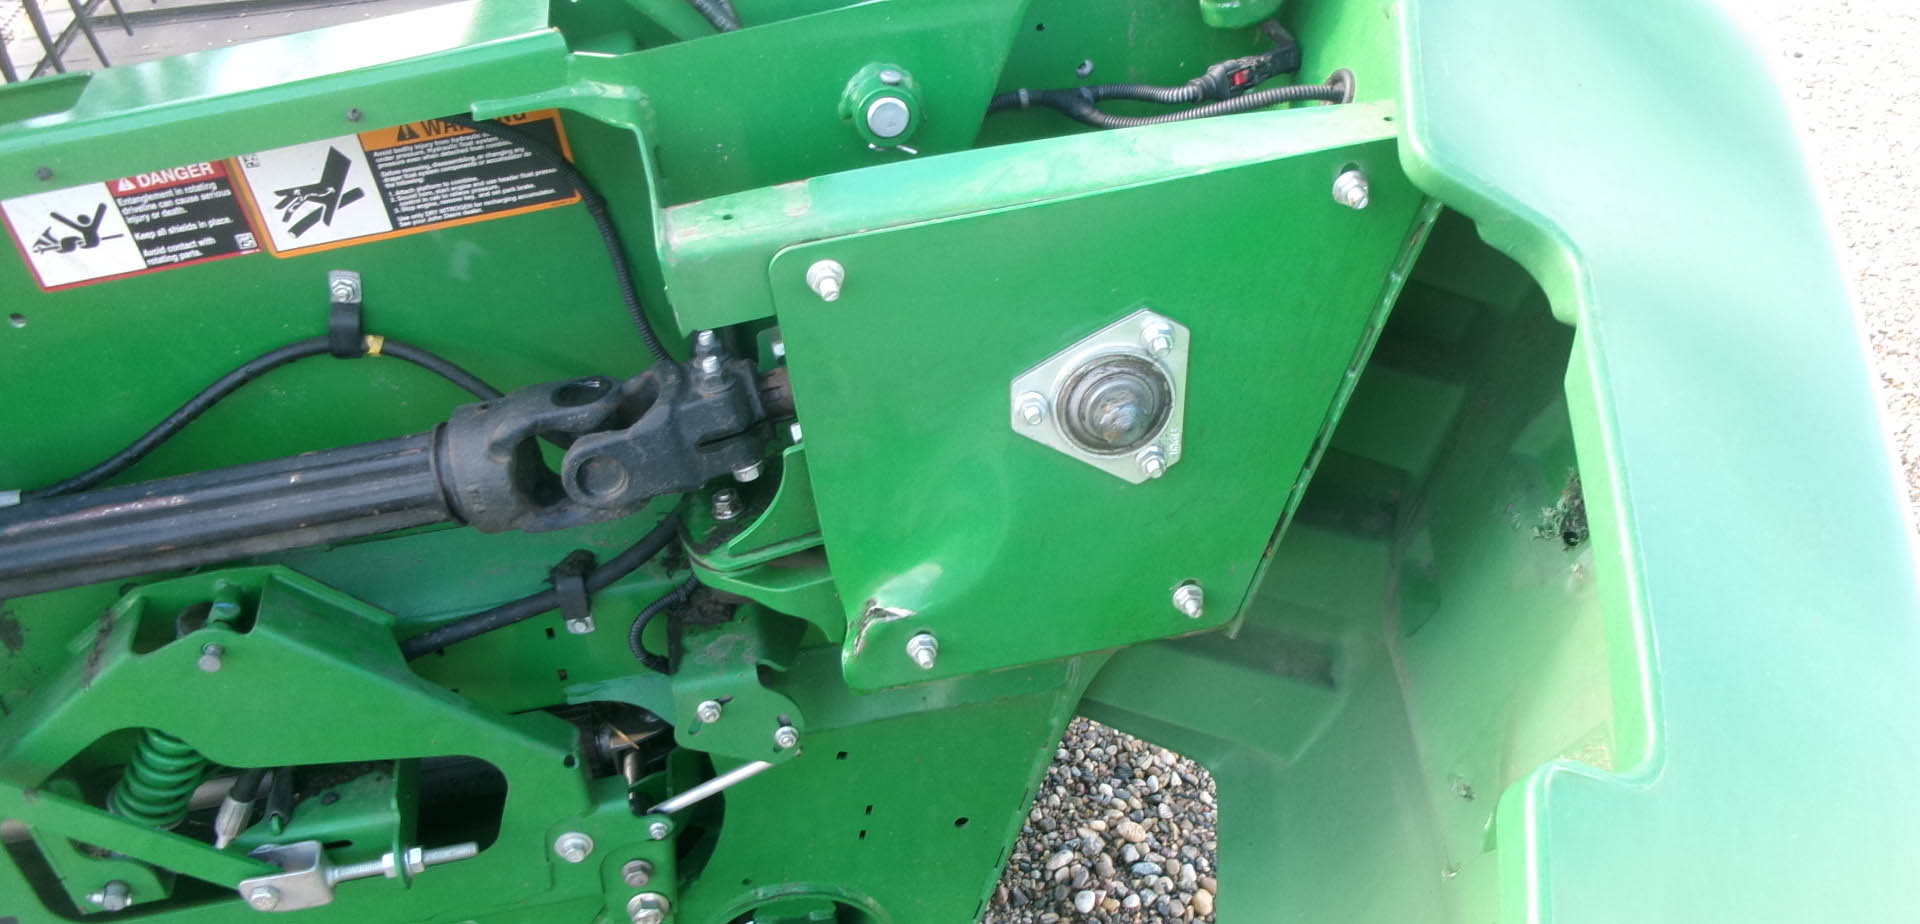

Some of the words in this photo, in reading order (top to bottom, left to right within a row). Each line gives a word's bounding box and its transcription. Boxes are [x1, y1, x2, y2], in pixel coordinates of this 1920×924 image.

[375, 155, 394, 163] under
[426, 144, 458, 153] Hydraulic
[393, 146, 412, 154] bodily
[413, 142, 433, 150] injury
[450, 133, 480, 143] hydraulic
[136, 163, 214, 187] DANGER
[117, 189, 173, 206] Entanglement
[174, 187, 183, 195] in
[184, 181, 217, 196] rotating
[416, 182, 442, 191] platform
[121, 202, 157, 215] driveline
[158, 200, 174, 208] can
[174, 195, 199, 205] cause
[199, 189, 231, 200] serious
[126, 213, 150, 225] injury
[160, 206, 187, 217] death.
[133, 230, 155, 241] Keep
[156, 228, 166, 236] all
[167, 222, 197, 234] shields
[208, 216, 233, 228] place.
[142, 246, 166, 256] Avoid
[166, 240, 197, 252] contact
[197, 237, 215, 246] with
[145, 253, 178, 266] rotating
[179, 249, 203, 260] parts.
